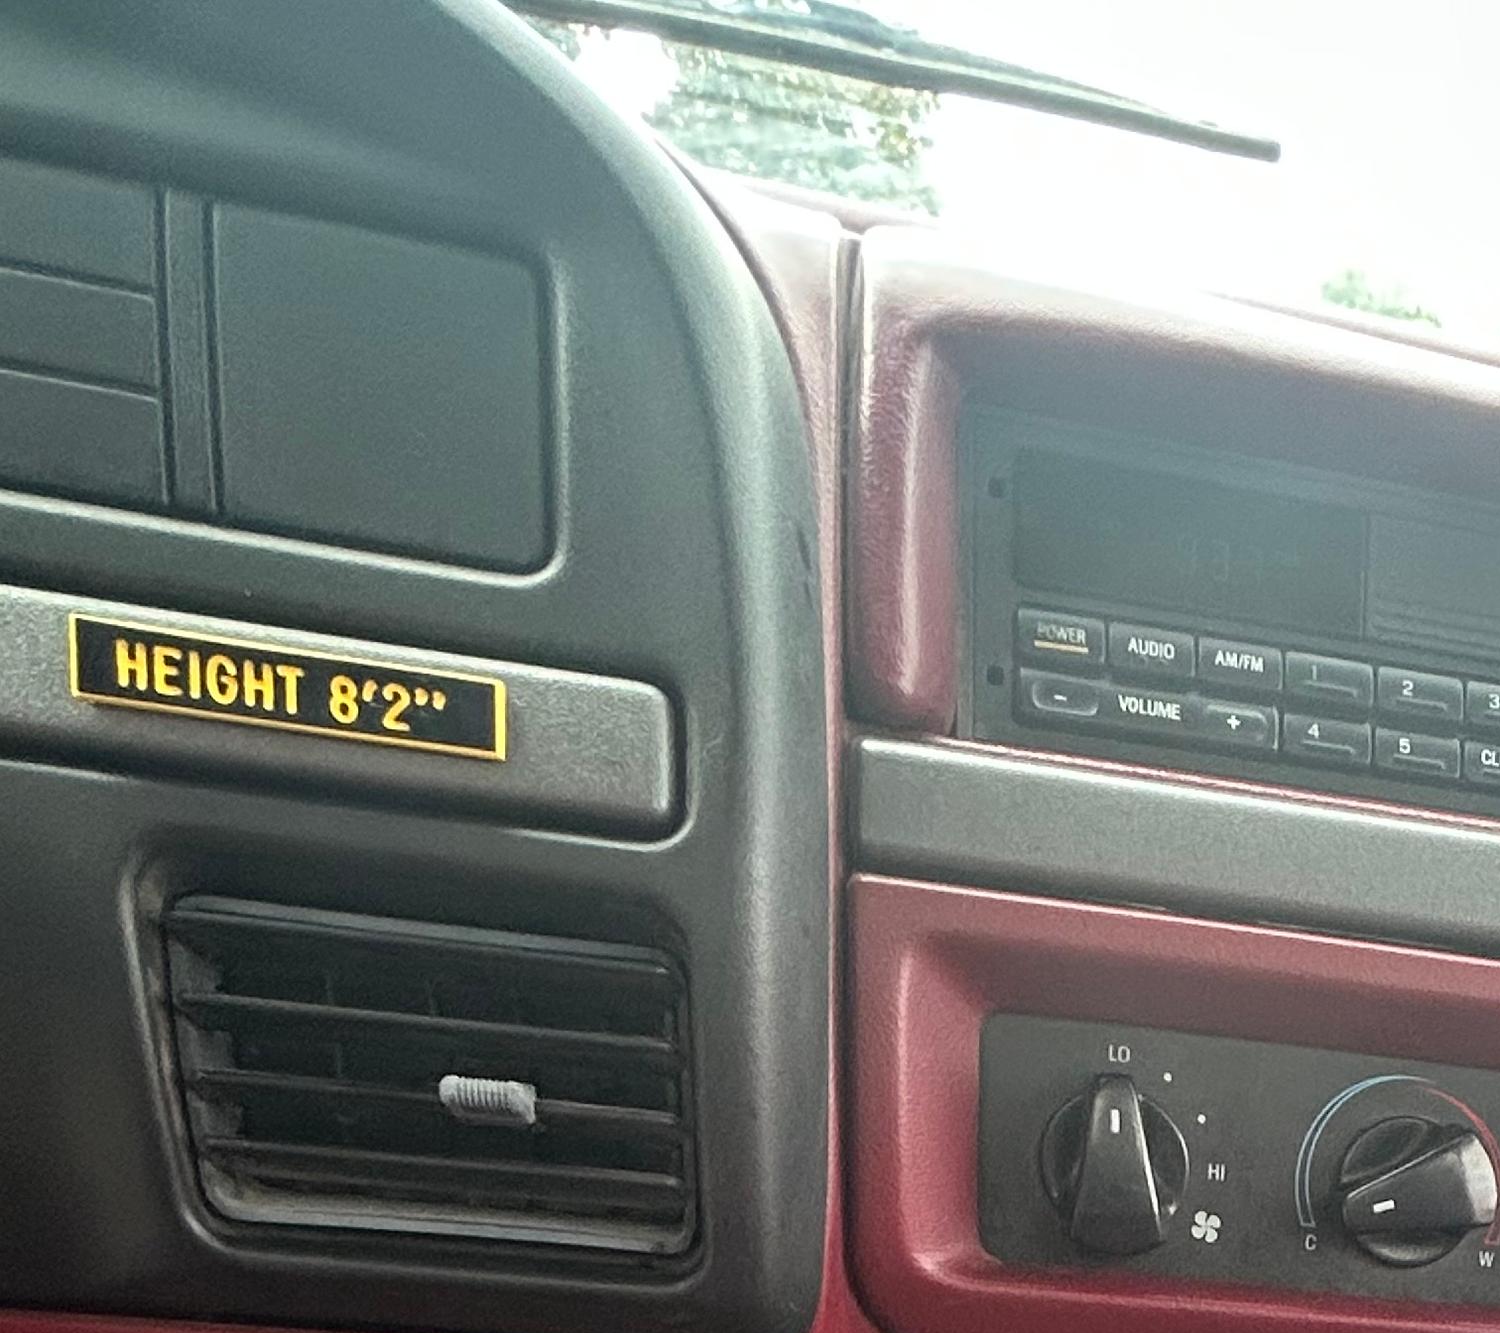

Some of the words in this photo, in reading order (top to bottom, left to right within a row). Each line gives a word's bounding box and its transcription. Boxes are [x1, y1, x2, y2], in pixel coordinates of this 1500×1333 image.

[1036, 622, 1087, 645] POWER
[1127, 636, 1176, 660] AUDIO
[1214, 650, 1265, 674] AM/FM
[113, 638, 305, 715] HEIGHT
[1401, 680, 1414, 698] 2
[1117, 693, 1182, 721] VOLUME
[1488, 693, 1500, 710] 3
[1306, 722, 1320, 739] 4
[1399, 738, 1412, 755] 5
[1107, 1044, 1131, 1063] LO
[1207, 1163, 1226, 1182] HI
[1304, 1234, 1317, 1252] C
[1477, 1251, 1495, 1268] W
